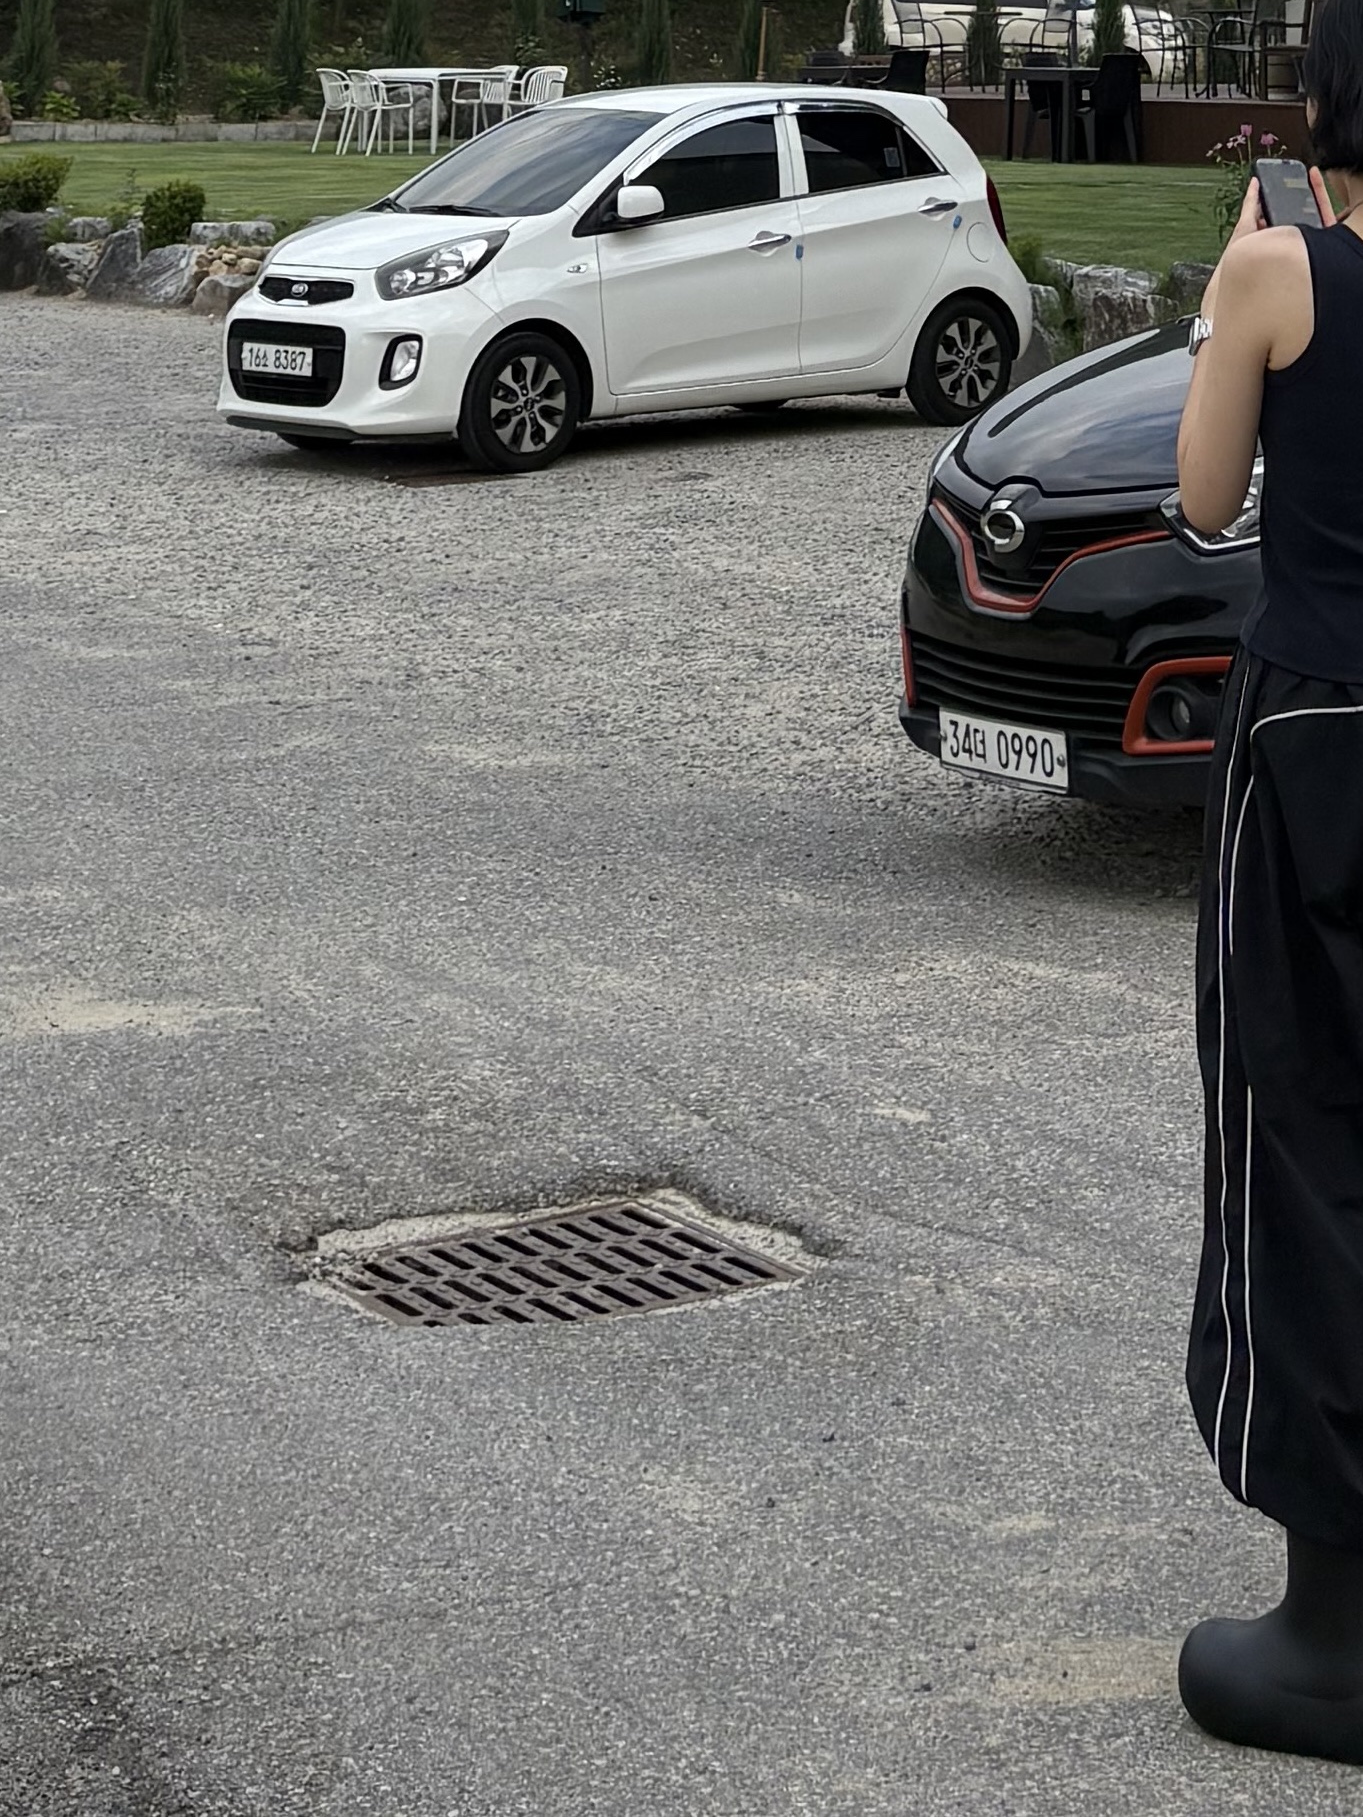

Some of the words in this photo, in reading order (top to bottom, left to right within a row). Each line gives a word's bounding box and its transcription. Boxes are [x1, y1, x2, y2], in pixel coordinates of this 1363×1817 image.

[249, 347, 268, 367] 16소
[273, 349, 306, 371] 8387
[949, 719, 987, 763] 34더
[996, 730, 1055, 778] 0990
